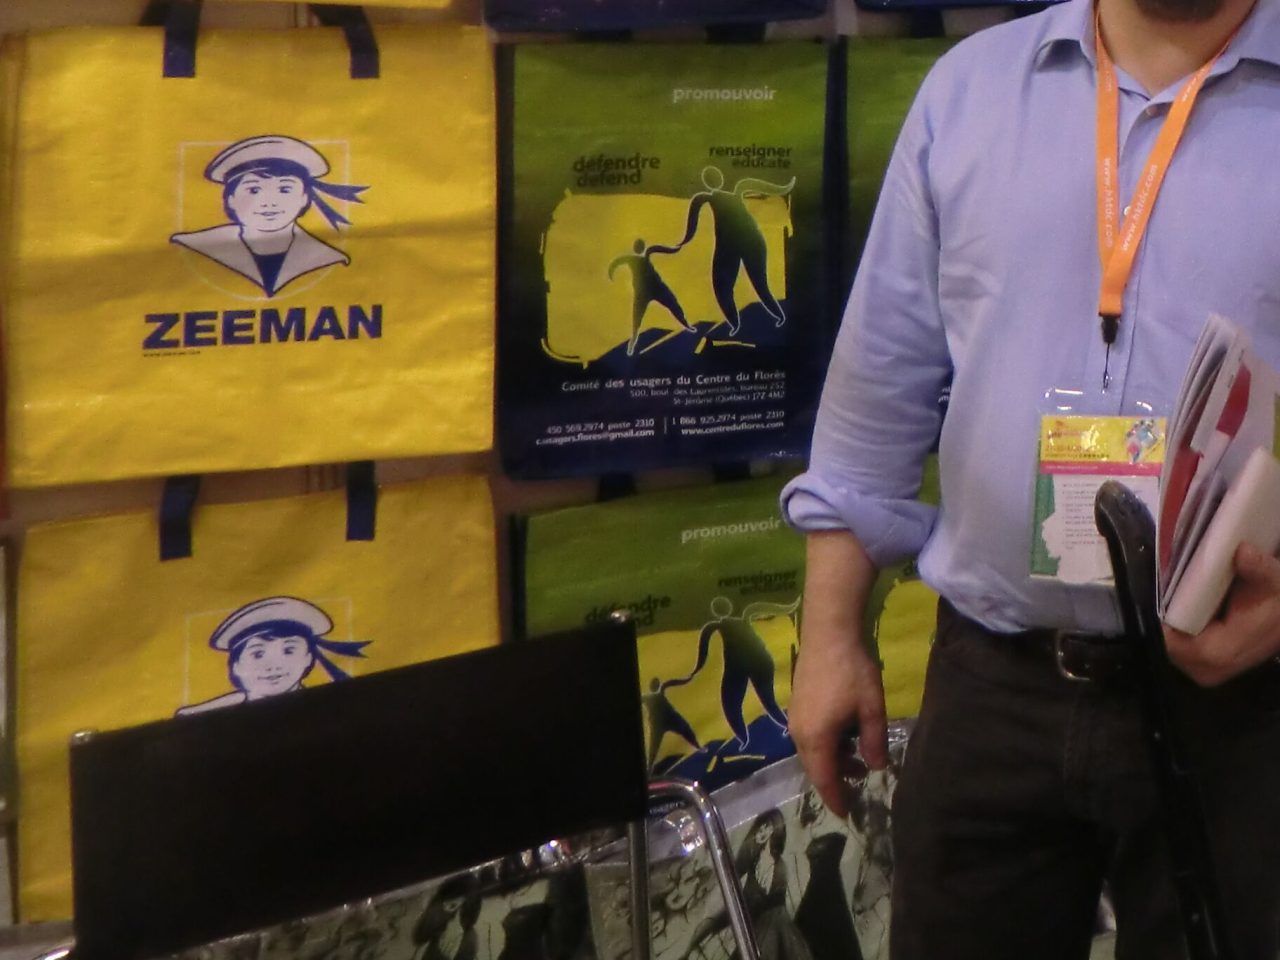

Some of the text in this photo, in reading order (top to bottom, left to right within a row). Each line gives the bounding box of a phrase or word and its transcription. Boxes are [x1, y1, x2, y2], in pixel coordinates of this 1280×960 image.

[672, 86, 776, 103] promouvoir
[709, 144, 792, 160] renseigner
[573, 152, 661, 173] défendre
[577, 170, 641, 187] defend
[1121, 164, 1158, 251] www.hktdc.com
[142, 304, 383, 350] ZEEMAN
[561, 380, 600, 391] Comité
[605, 379, 624, 388] des
[629, 378, 672, 388] usagers
[677, 376, 690, 385] du
[695, 374, 731, 385] Centre
[736, 371, 750, 381] du
[681, 516, 783, 544] promouvoir
